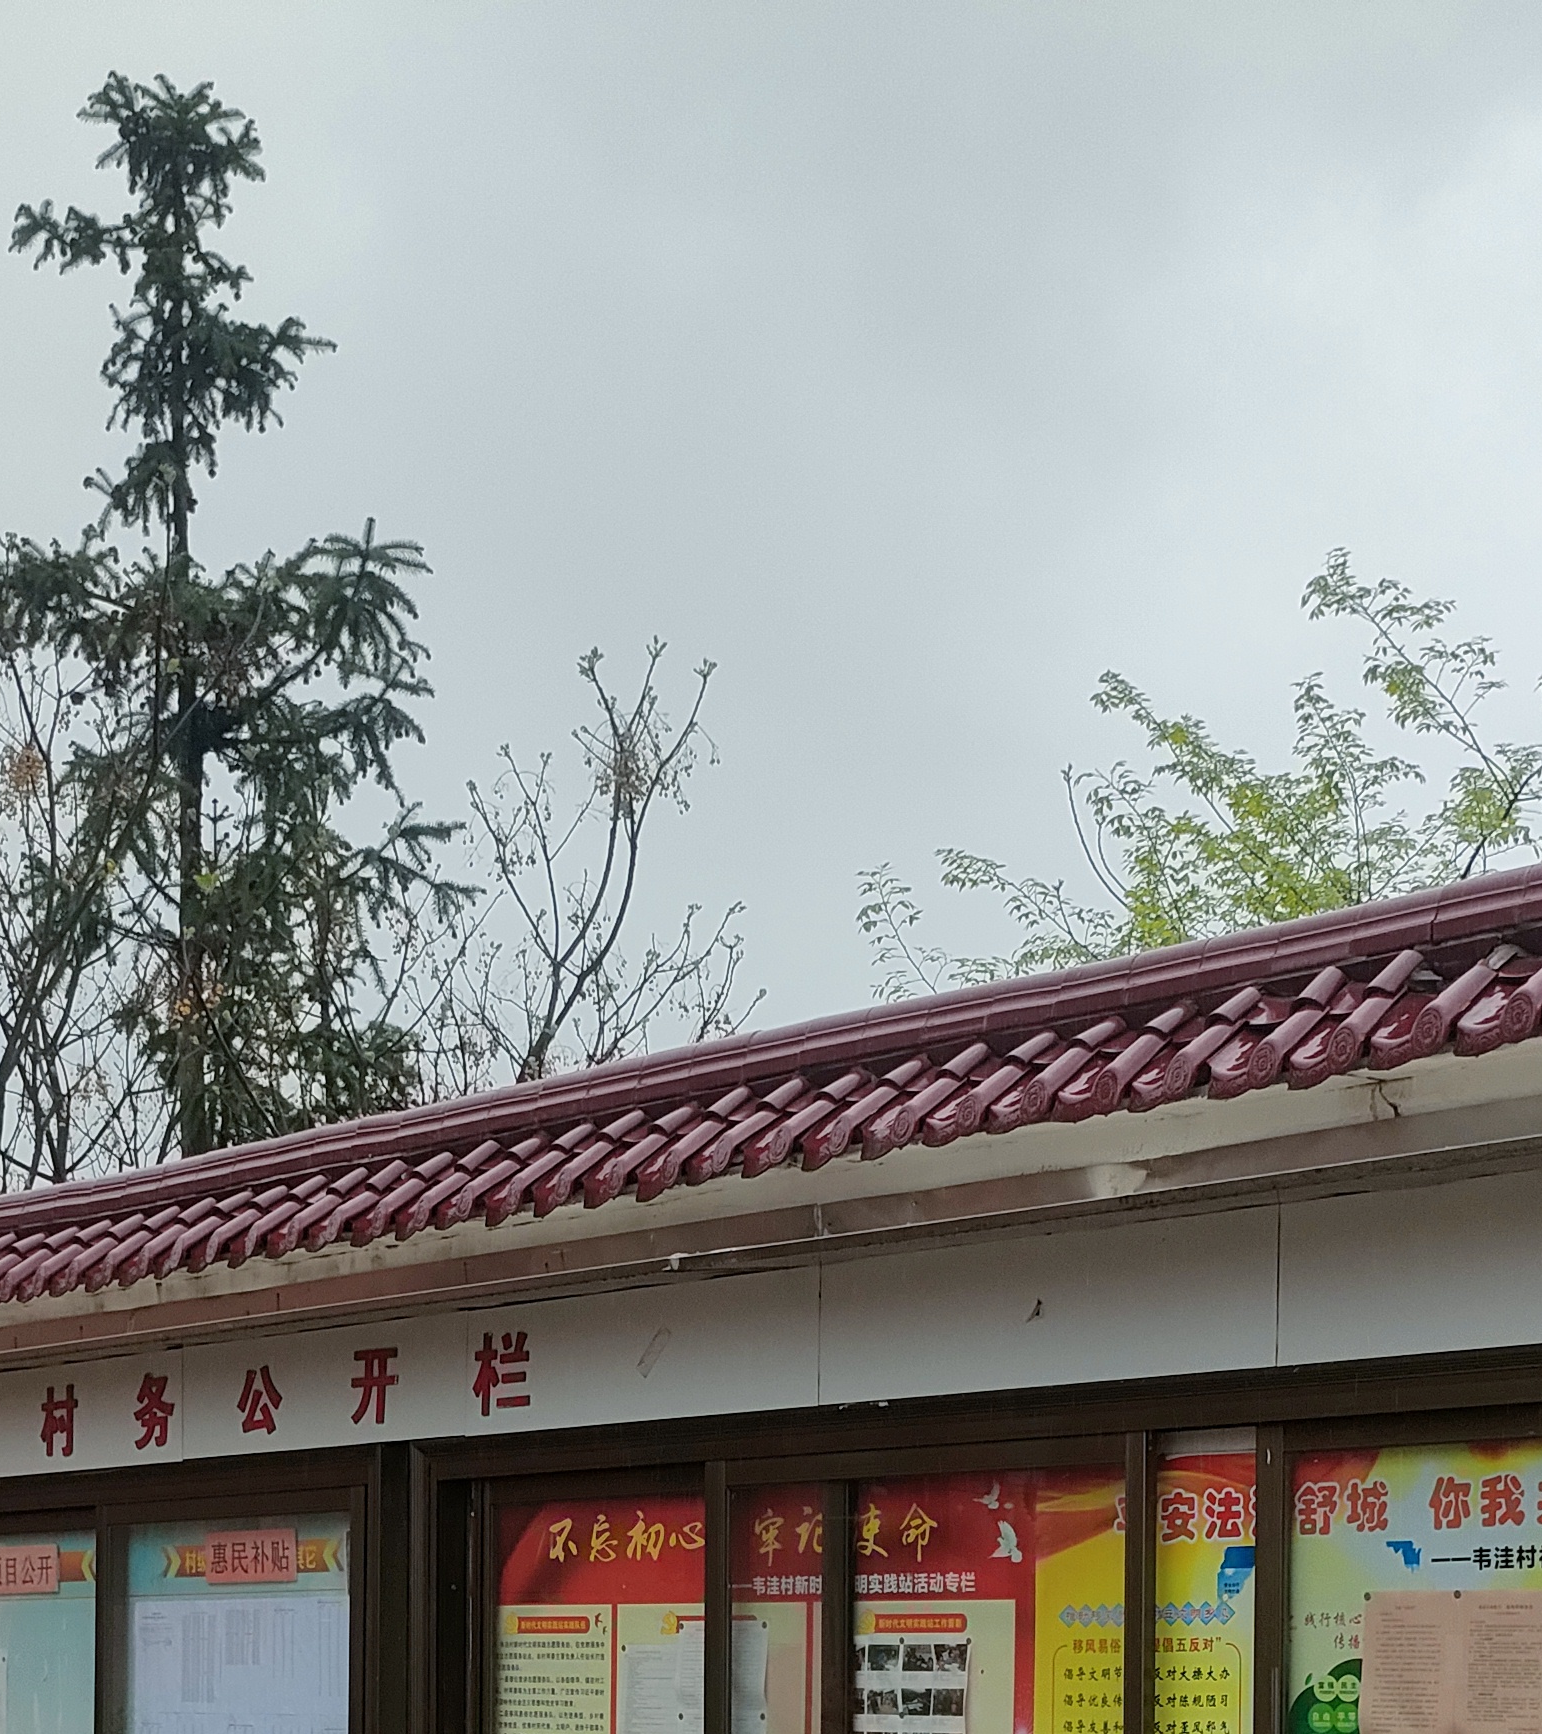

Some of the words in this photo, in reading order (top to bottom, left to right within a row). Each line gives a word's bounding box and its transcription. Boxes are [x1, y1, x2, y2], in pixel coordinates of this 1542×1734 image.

[1295, 1479, 1390, 1536] 舒城
[211, 1540, 289, 1574] 惠民补贴
[548, 1510, 705, 1563] 不忘初心
[1072, 1638, 1121, 1655] 移风易俗
